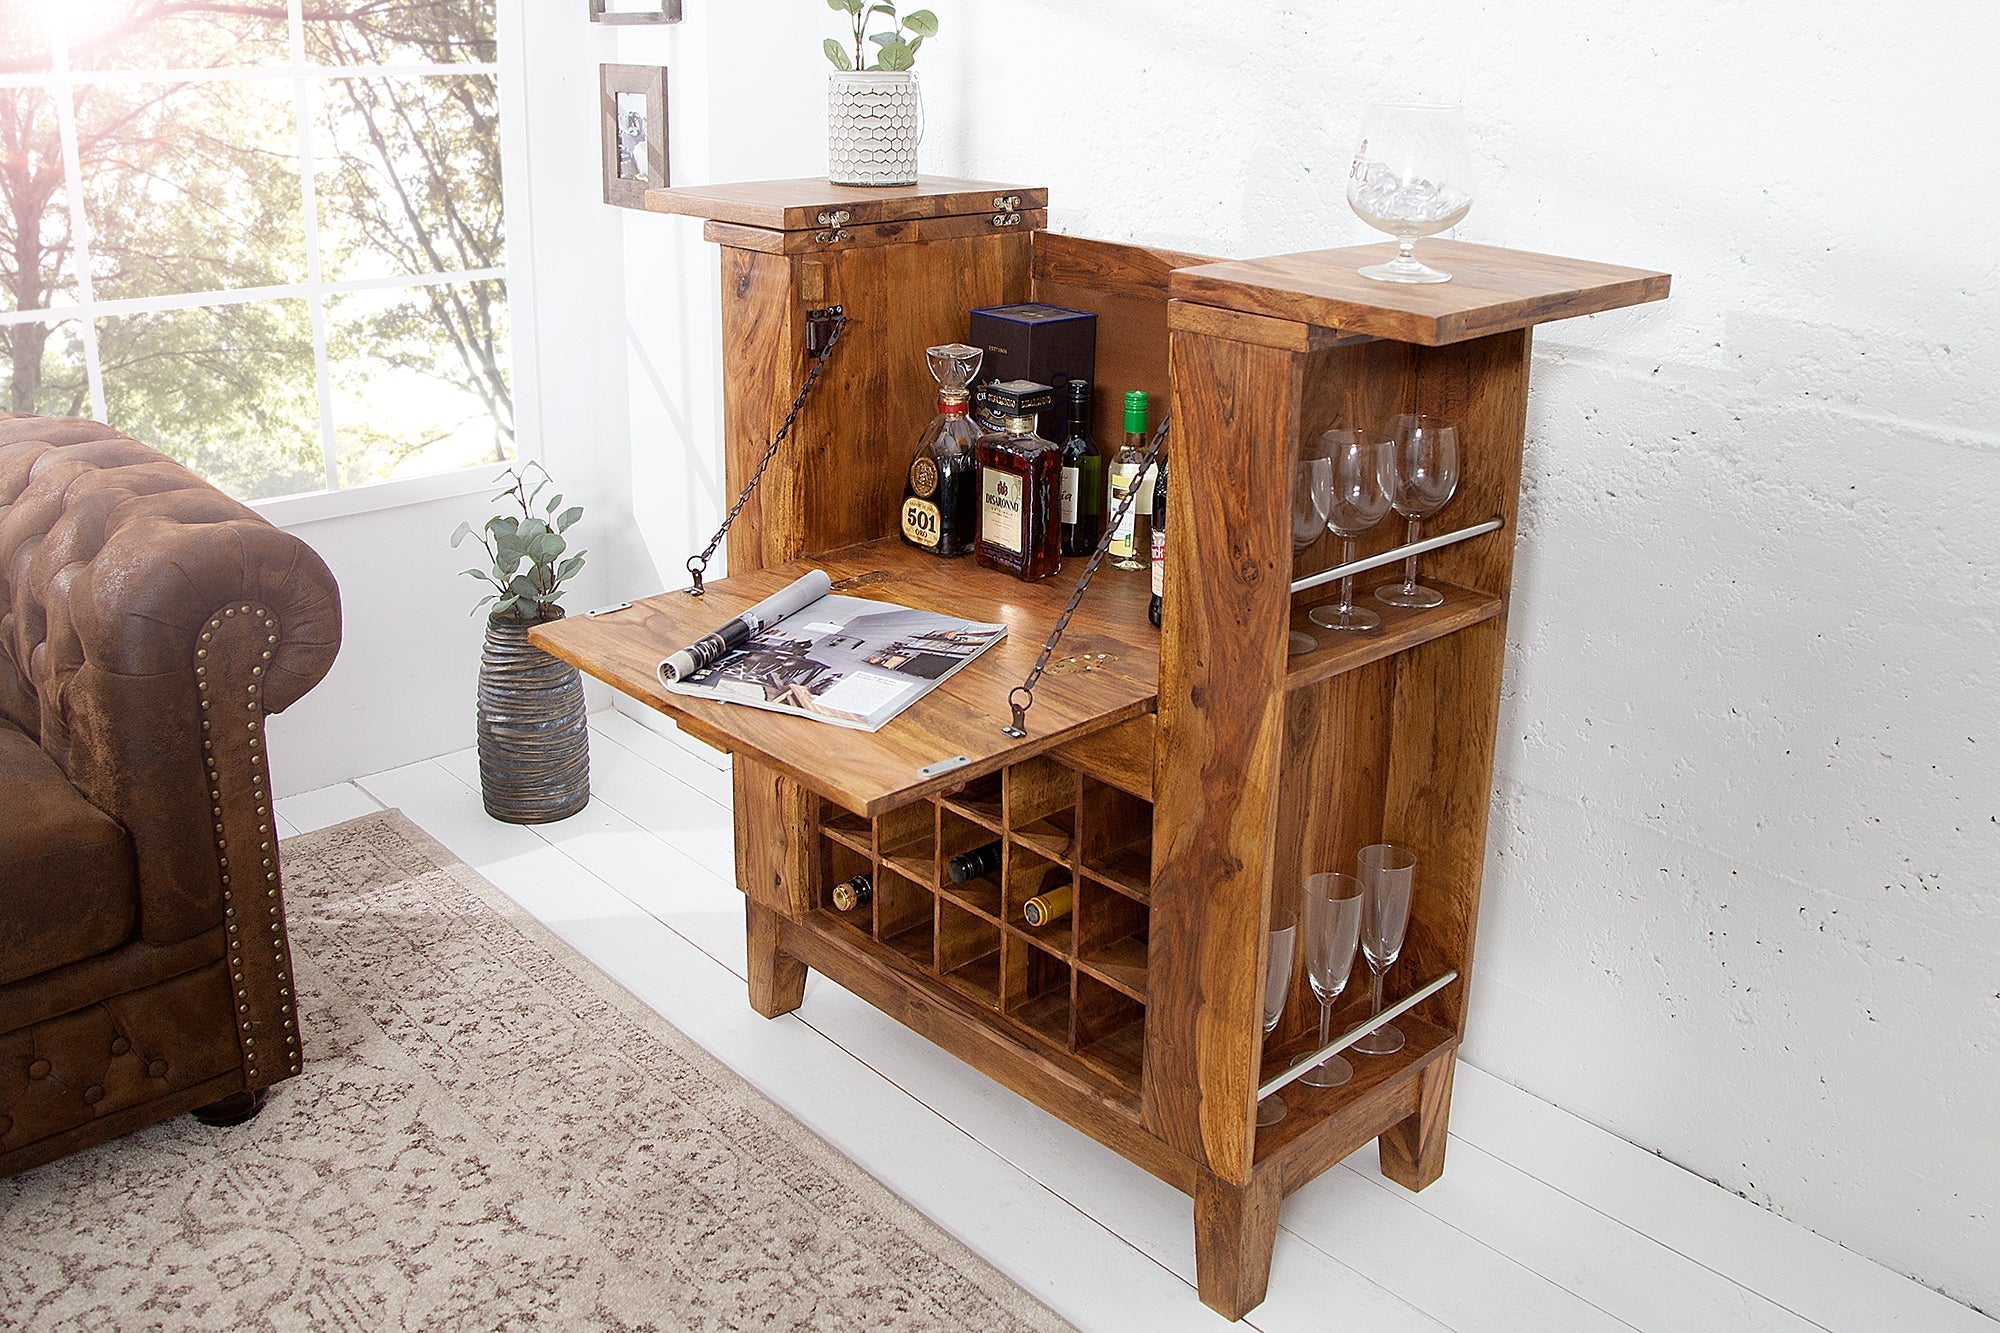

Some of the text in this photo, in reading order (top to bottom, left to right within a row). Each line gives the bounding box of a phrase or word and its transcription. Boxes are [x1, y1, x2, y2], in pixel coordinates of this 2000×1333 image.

[1350, 160, 1369, 182] 501
[985, 493, 1019, 512] DISARONNO
[907, 507, 936, 534] 501
